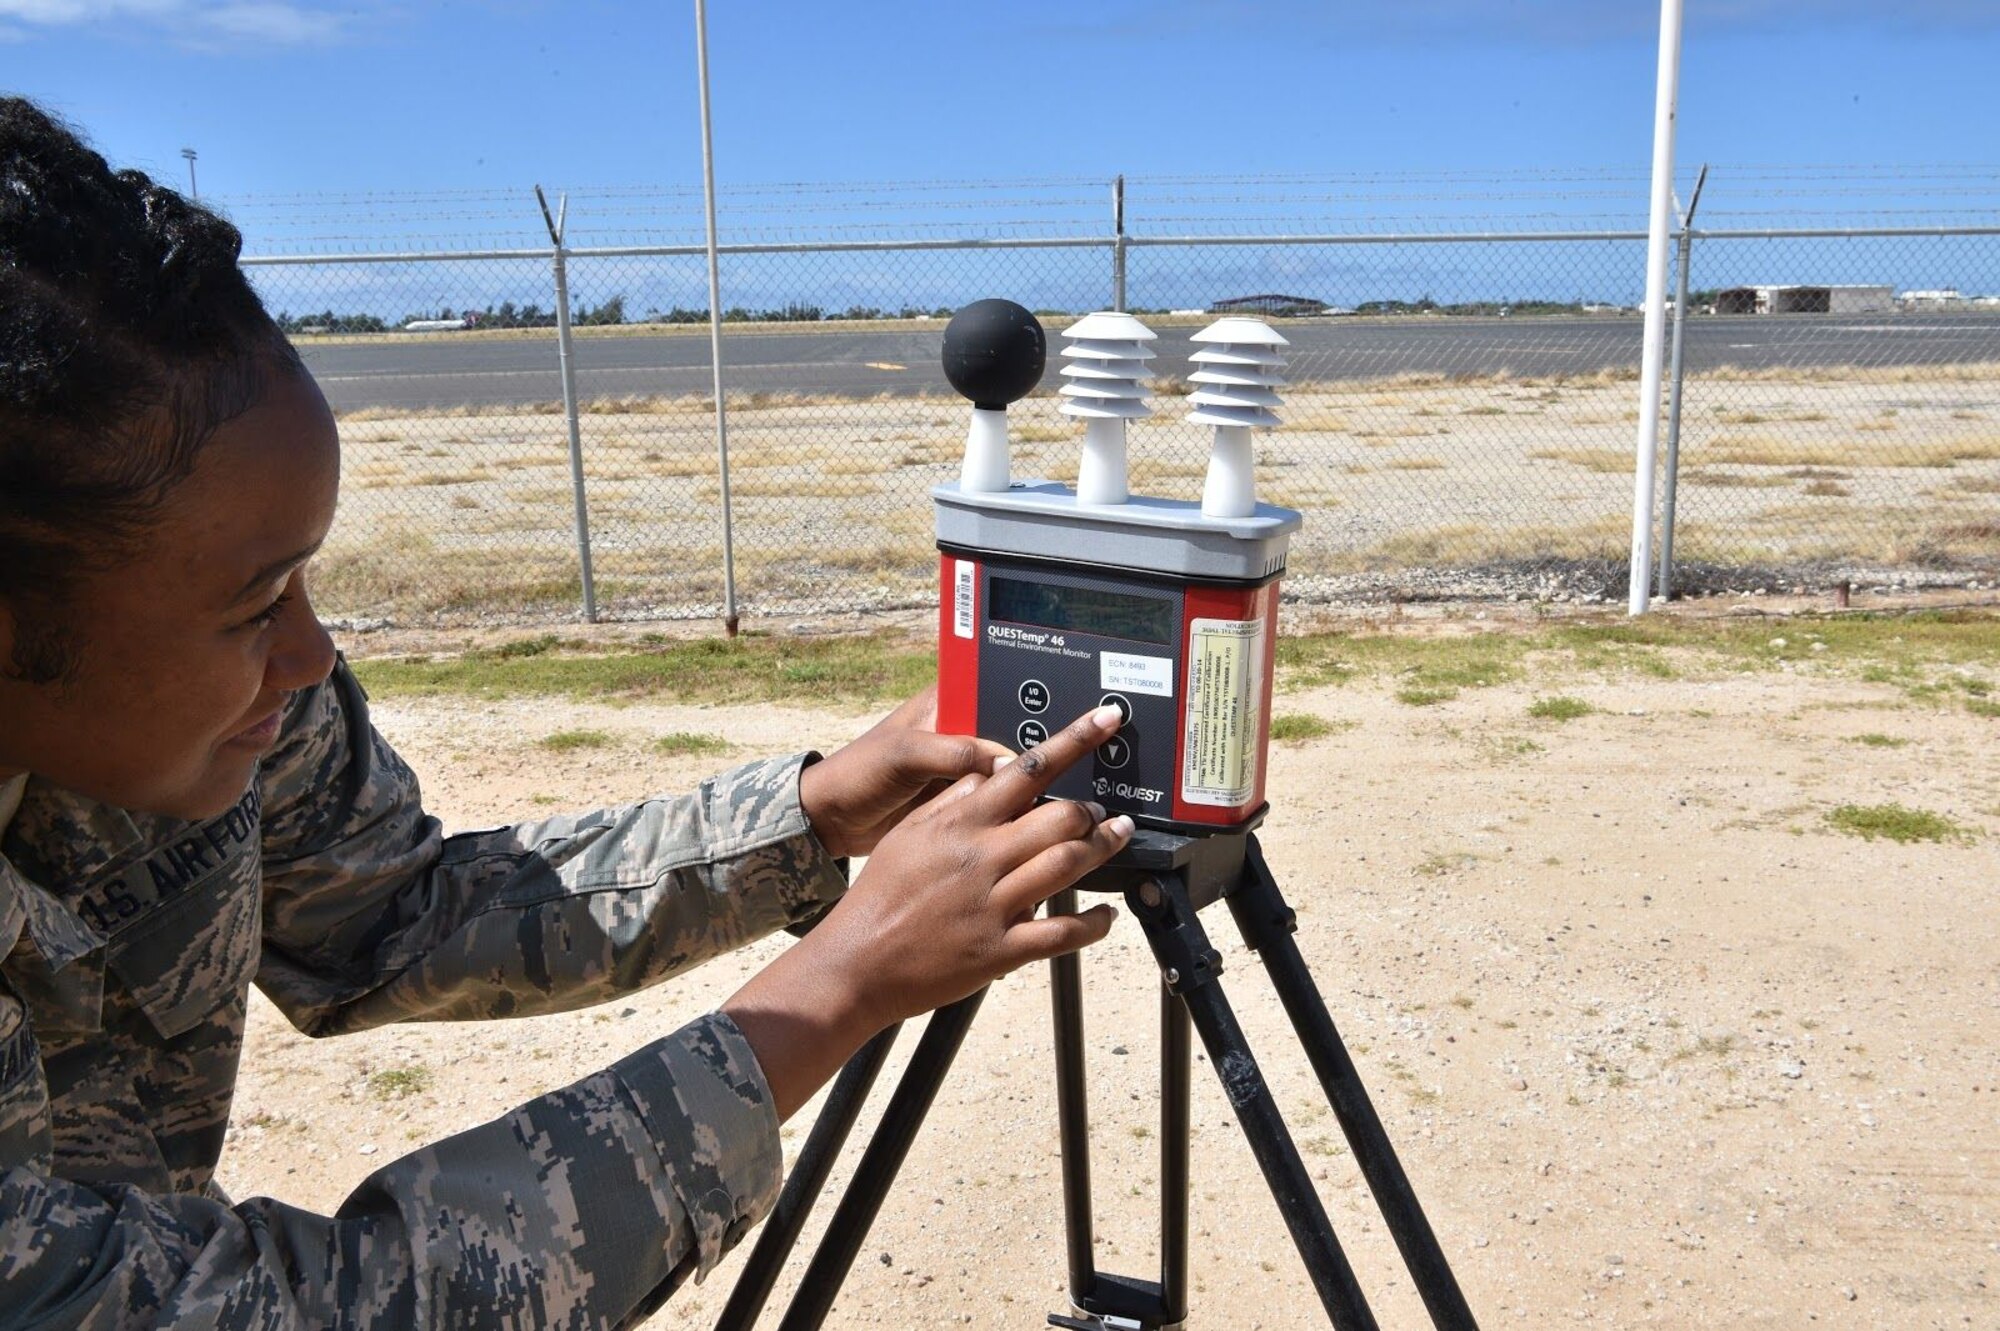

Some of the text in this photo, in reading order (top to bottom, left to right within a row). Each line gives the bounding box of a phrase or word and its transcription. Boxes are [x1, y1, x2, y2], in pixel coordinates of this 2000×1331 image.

[1050, 635, 1066, 647] 46
[988, 635, 1092, 660] Thermal Environment Monitor
[1108, 659, 1127, 668] ECN:
[1108, 675, 1121, 684] SN:
[1024, 696, 1043, 707] Enter
[1025, 726, 1040, 737] Run
[1218, 756, 1226, 785] Calibrated
[1115, 783, 1165, 803] QUEST
[145, 837, 215, 898] AIR
